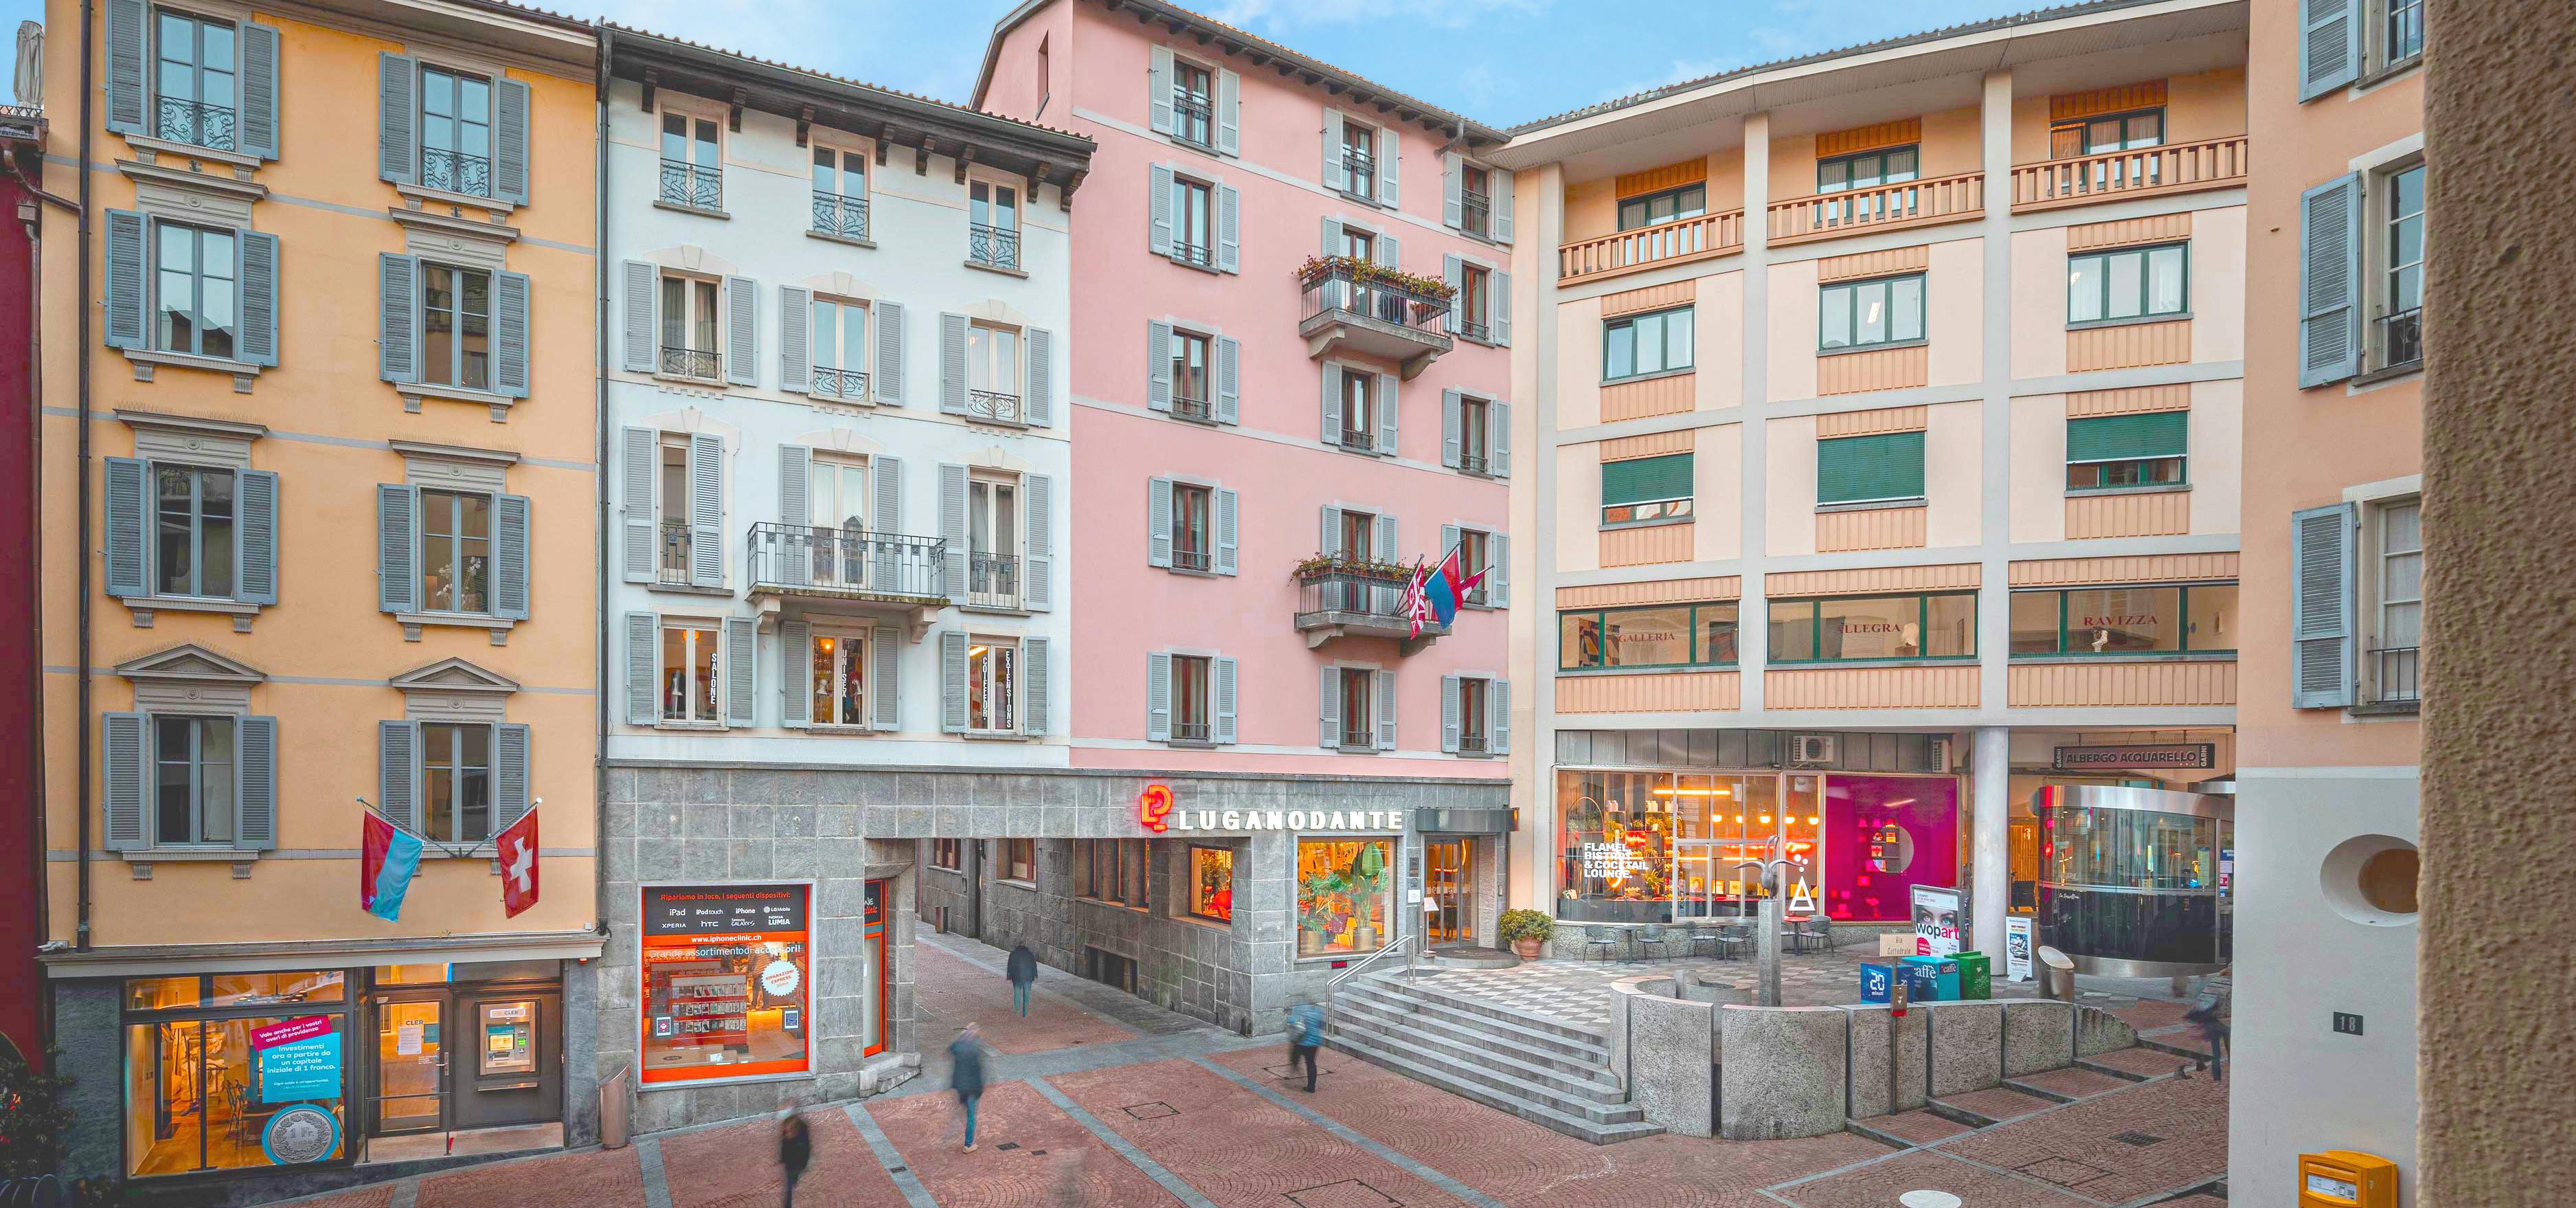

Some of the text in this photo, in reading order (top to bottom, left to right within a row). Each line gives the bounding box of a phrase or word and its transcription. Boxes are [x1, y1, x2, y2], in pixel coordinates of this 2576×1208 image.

[2084, 615, 2158, 625] RAVIZZA
[1837, 623, 1901, 634] ALLEGRA
[1618, 632, 1675, 642] GALLERIA
[2066, 751, 2197, 763] ALBERGO ACQUARELLO
[1179, 809, 1403, 830] LUGANODANTE
[1584, 851, 1631, 860] BISTROT
[1584, 860, 1649, 871] & COCKTAIL
[1584, 869, 1633, 879] LOUNGE.
[726, 892, 755, 901] seguenti
[756, 891, 791, 900] dispositivi:
[670, 908, 686, 917] iPad
[1916, 923, 1960, 941] wopart
[691, 935, 762, 944] www.iphoneclinic.ch
[648, 950, 683, 959] Grande
[1887, 947, 1911, 955] Cattedrale
[771, 975, 792, 984] EXPRESS
[1870, 972, 1885, 991] 20
[273, 1027, 291, 1035] anche
[305, 1019, 322, 1027] vostri
[2340, 1016, 2355, 1032] 18
[265, 1033, 281, 1042] averi
[288, 1026, 319, 1038] previdenza
[278, 1042, 324, 1052] Investimenti
[293, 1051, 319, 1060] partire
